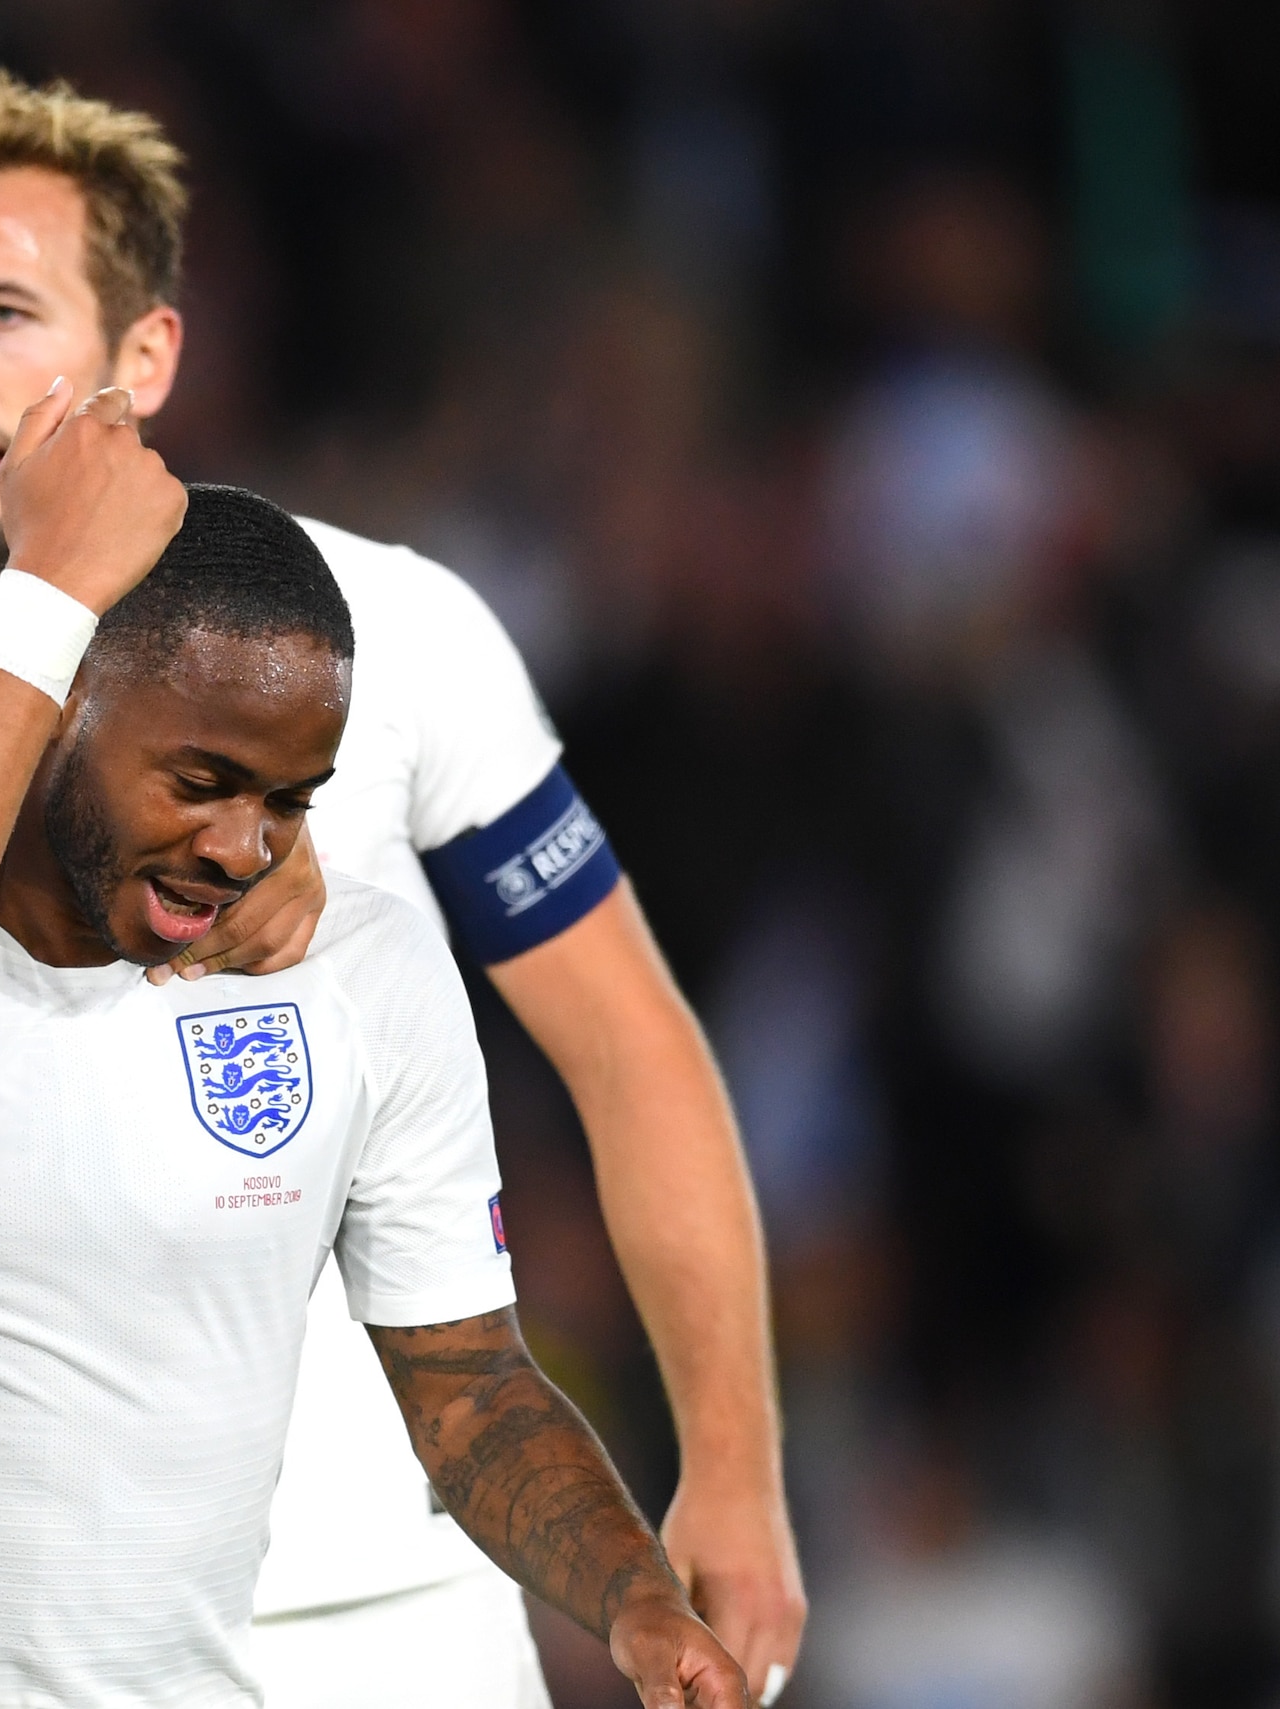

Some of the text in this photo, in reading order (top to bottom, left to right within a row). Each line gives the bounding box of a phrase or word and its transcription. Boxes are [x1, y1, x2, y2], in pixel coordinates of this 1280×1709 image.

[243, 1175, 281, 1190] KOSOVO
[215, 1189, 302, 1209] 10 SEPTEMBER 2019
